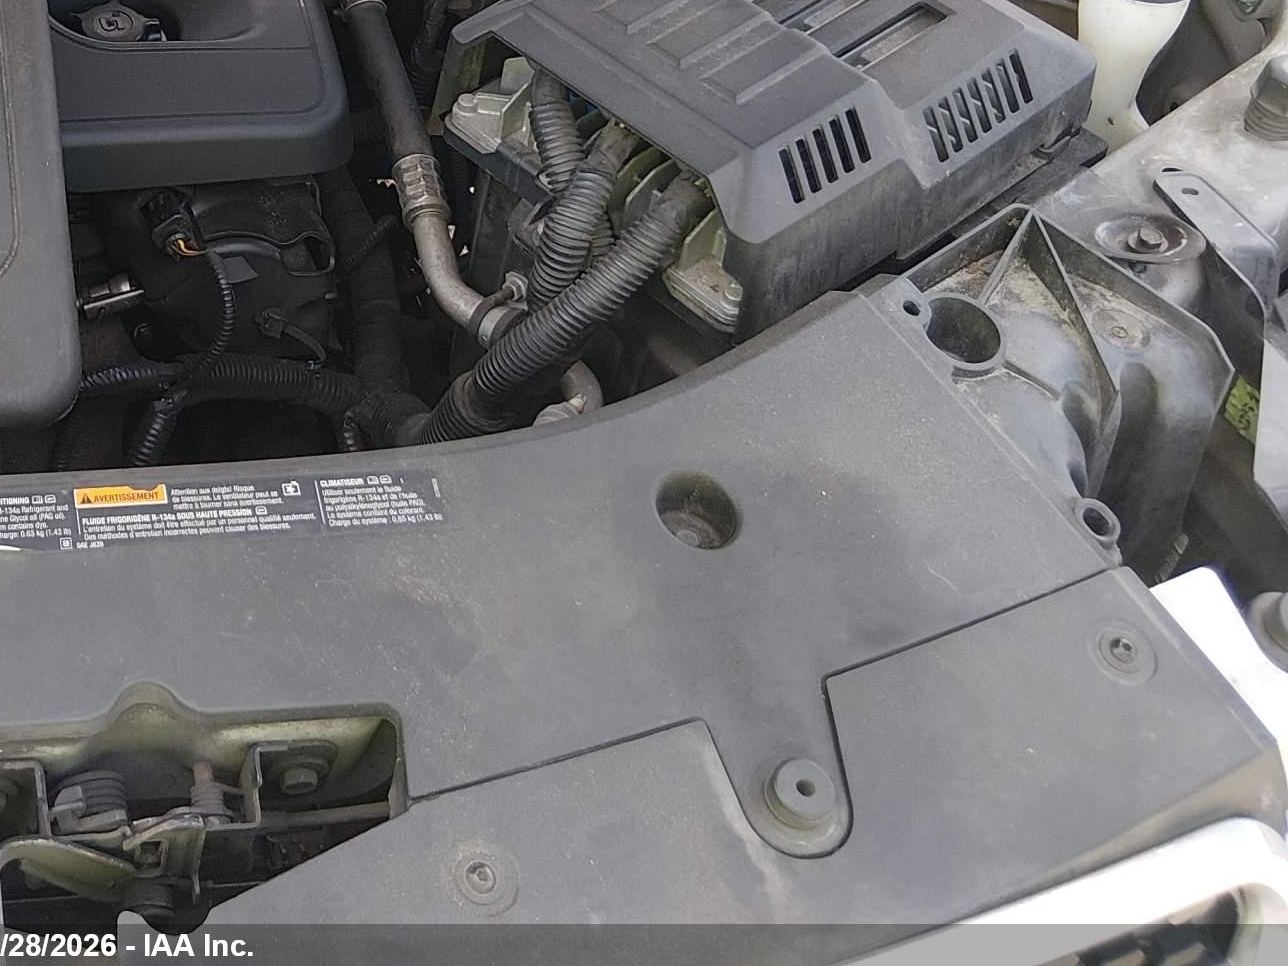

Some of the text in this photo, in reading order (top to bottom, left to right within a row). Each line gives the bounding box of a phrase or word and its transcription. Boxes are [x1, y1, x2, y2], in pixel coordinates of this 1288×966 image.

[320, 477, 365, 487] CLIMATISEUR
[94, 491, 159, 503] AVERTISSEMENT
[82, 517, 106, 525] FLUIDE
[151, 513, 176, 521] R-134a
[176, 511, 195, 520] SOUS
[195, 510, 218, 518] HAUTE
[218, 508, 252, 517] PRESSION
